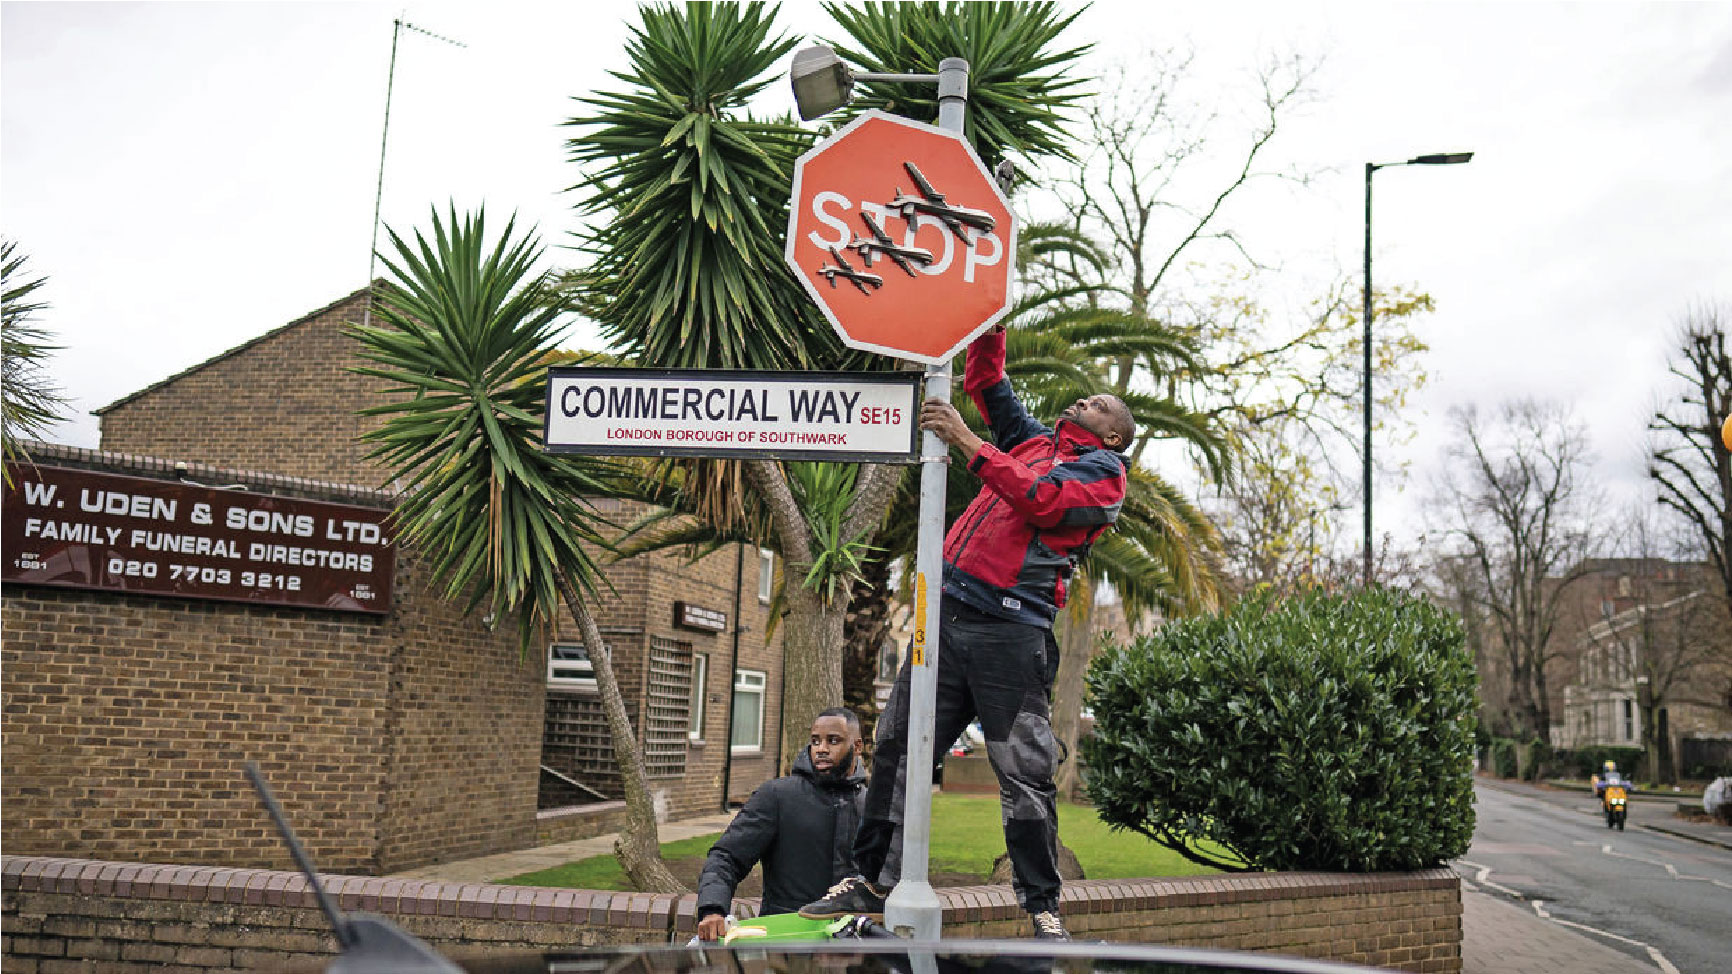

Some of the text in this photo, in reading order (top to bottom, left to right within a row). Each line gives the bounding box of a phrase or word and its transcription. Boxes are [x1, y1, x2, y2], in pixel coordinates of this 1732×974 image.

[808, 191, 1003, 283] STOP
[561, 385, 901, 425] COMMERCIAL WAY SE15
[607, 428, 848, 445] LONDON BOROUGH OF SOUTHWARK
[24, 480, 388, 546] W. UDEN & SONS LTD.
[25, 518, 373, 573] FAMILY FUNERAL DIRECTORS
[108, 558, 301, 591] 020 7703 3212
[916, 629, 925, 643] 3
